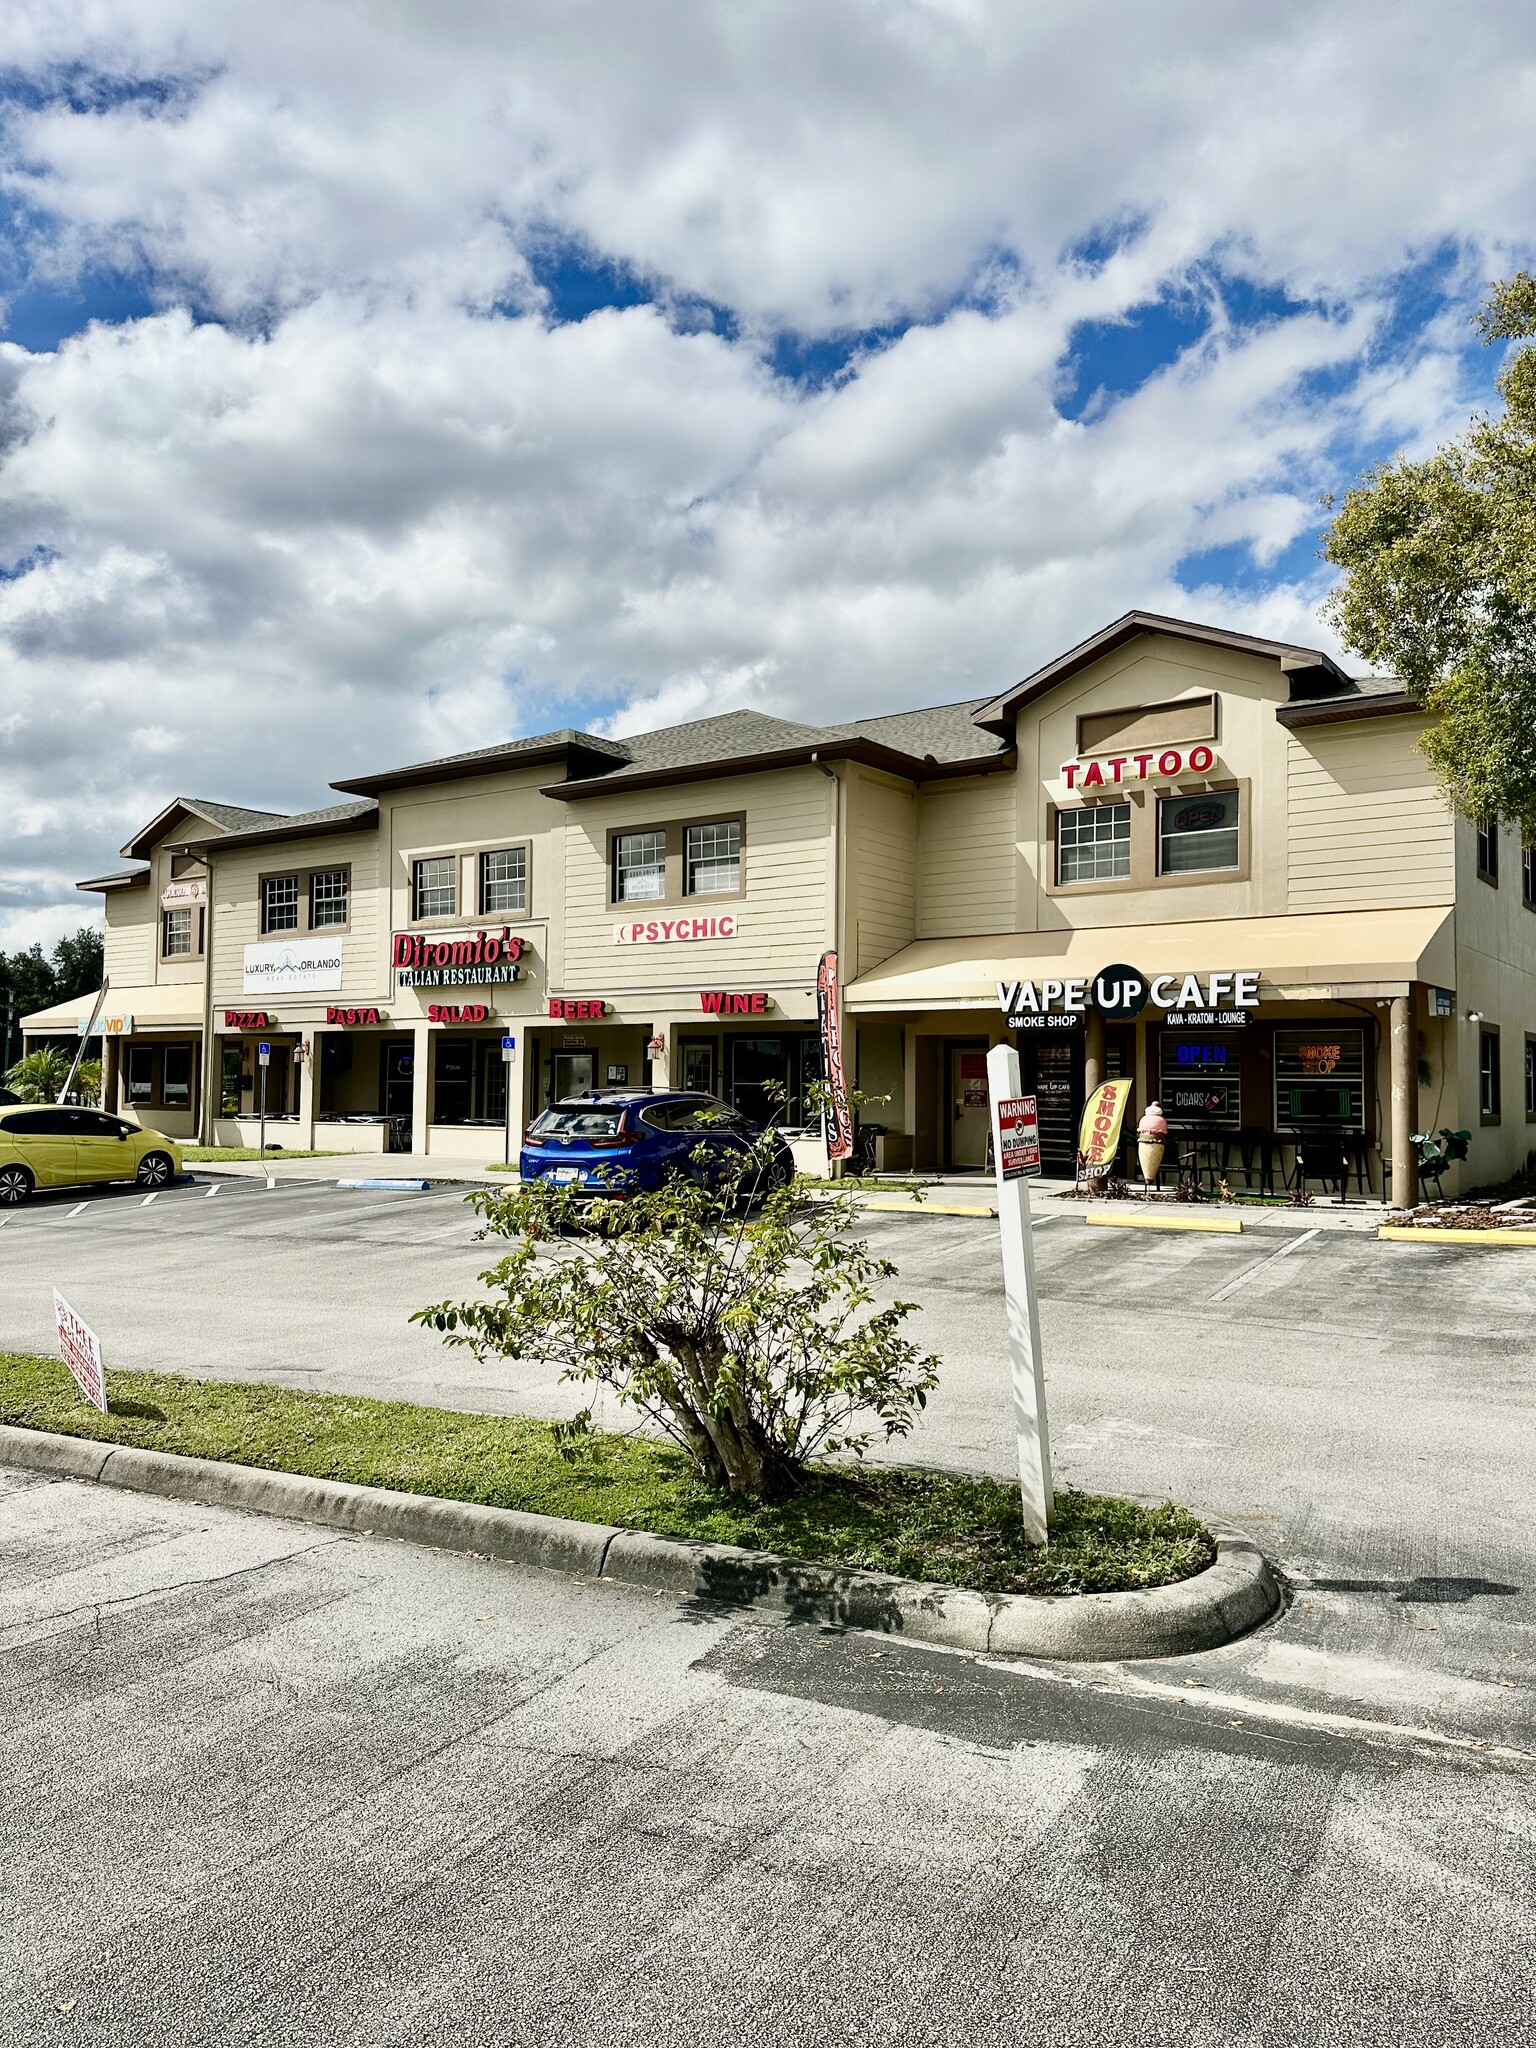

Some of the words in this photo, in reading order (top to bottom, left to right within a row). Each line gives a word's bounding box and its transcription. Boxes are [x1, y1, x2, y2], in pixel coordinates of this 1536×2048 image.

[1062, 746, 1213, 789] TATTOO
[1175, 805, 1224, 828] OPEN
[632, 916, 734, 942] PSYCHIC
[392, 926, 524, 968] Diromio's
[245, 963, 275, 974] LUXURY
[300, 959, 341, 970] ORLANDO
[289, 973, 316, 981] ESTATE
[397, 969, 440, 987] ITALIAN
[443, 965, 516, 985] RESTAURANT
[995, 979, 1088, 1013] VAPE
[1096, 977, 1142, 1009] UP
[1150, 972, 1260, 1009] CAFE
[549, 998, 605, 1018] BEER
[700, 992, 768, 1013] WINE
[225, 1010, 267, 1027] PIZZA
[327, 1007, 380, 1025] PASTA
[428, 1004, 487, 1022] SALAD
[1008, 1017, 1045, 1028] SMOKE
[1047, 1015, 1077, 1027] SHOP
[1167, 1014, 1184, 1025] KAVA
[1187, 1013, 1214, 1025] KRATOM
[1218, 1012, 1246, 1024] LOUNGE
[1177, 1045, 1227, 1064] OPEN
[1299, 1045, 1341, 1060] SMOKE
[1303, 1060, 1336, 1074] SHOP
[1176, 1092, 1204, 1107] CIGARS
[1000, 1100, 1035, 1118] WARNING
[1088, 1085, 1117, 1162] SMOKE
[1003, 1139, 1011, 1149] NO
[1013, 1135, 1036, 1148] DUMPING
[1003, 1150, 1014, 1159] AREA
[1014, 1148, 1027, 1158] UNDER
[1027, 1146, 1038, 1155] VIDEO
[1008, 1154, 1035, 1167] SURVEILLANCE
[1078, 1163, 1112, 1180] SHOP
[69, 1311, 95, 1356] TREE
